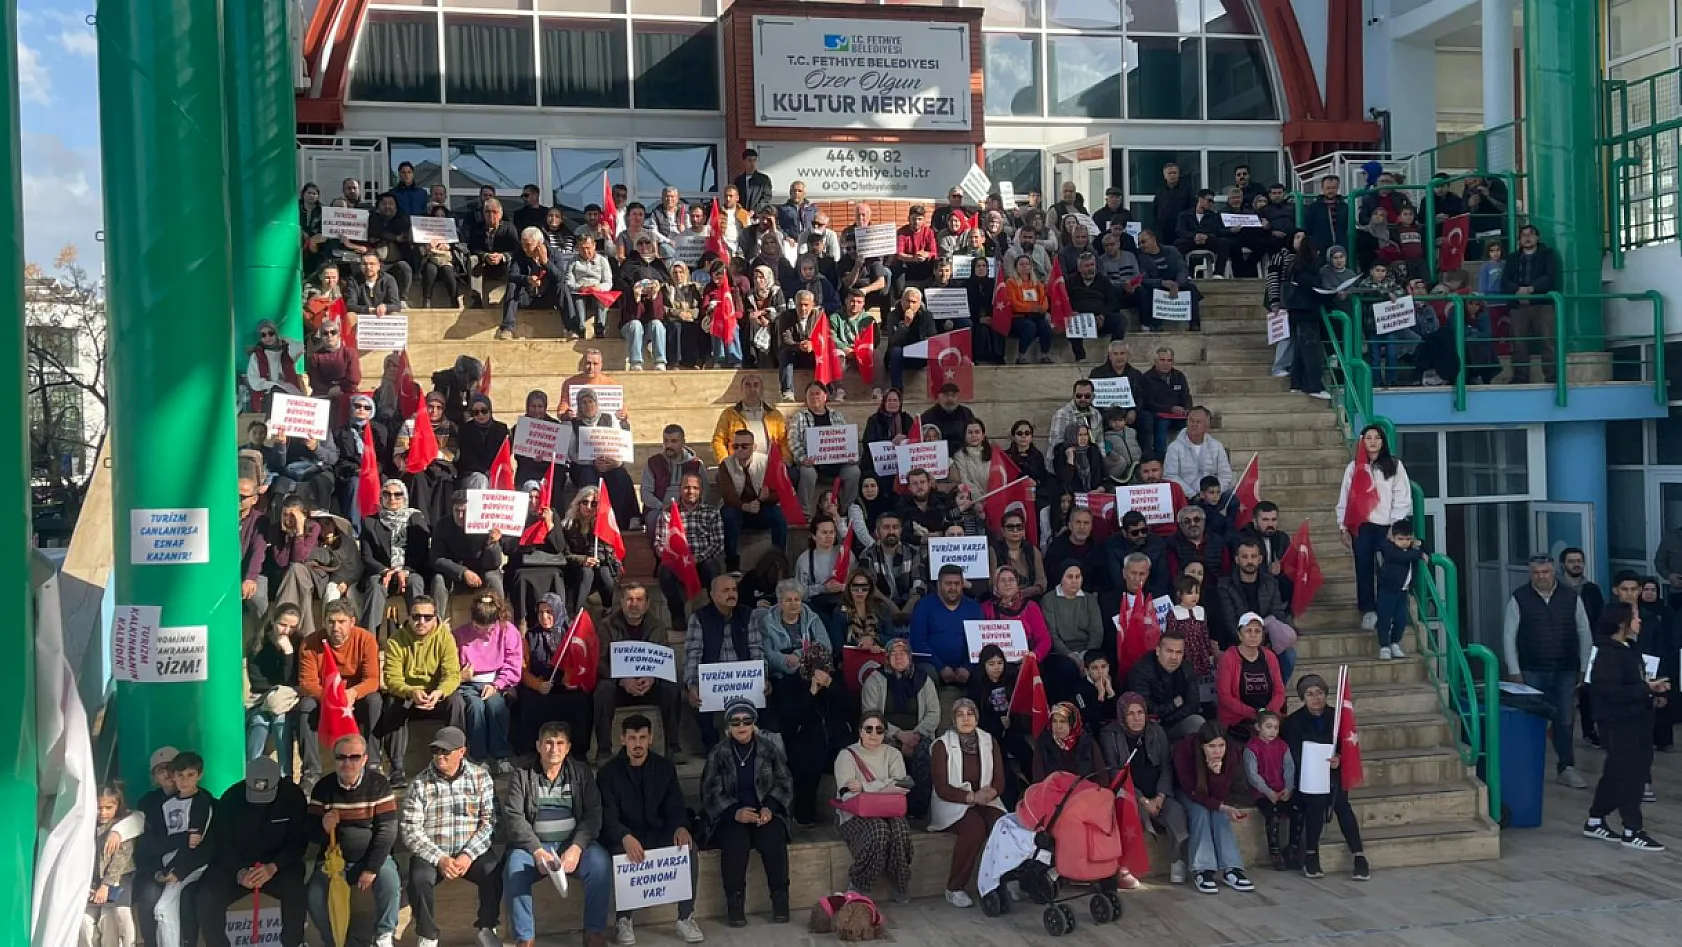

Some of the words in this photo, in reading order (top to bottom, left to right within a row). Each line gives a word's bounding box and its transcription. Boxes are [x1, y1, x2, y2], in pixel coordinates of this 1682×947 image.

[786, 55, 810, 66] T.C.
[804, 68, 856, 88] Özer
[860, 72, 922, 95] Olgun
[772, 93, 856, 114] KÜLTÜR
[861, 96, 954, 116] MERKEZİ
[826, 150, 855, 162] 444
[859, 150, 878, 162] 90
[883, 150, 902, 163] 82
[797, 166, 931, 180] www.fethiye.bel.tr
[152, 512, 188, 522] TURİZM
[154, 540, 184, 548] ESNAF
[932, 542, 960, 552] TURİZM
[962, 543, 986, 551] VARSA
[942, 553, 978, 562] EKONOMİ
[140, 624, 151, 664] TURİZM
[614, 646, 646, 654] TURİZM
[648, 648, 674, 660] VARSA
[156, 656, 202, 676] RİZM!
[624, 656, 665, 665] EKONOMİ
[635, 664, 656, 672] VAR!
[702, 670, 733, 681] TURİZM
[736, 669, 762, 678] VARSA
[712, 679, 754, 693] EKONOMİ
[657, 856, 688, 868] VARSA
[630, 868, 677, 886] EKONOMİ
[643, 886, 666, 900] VAR!
